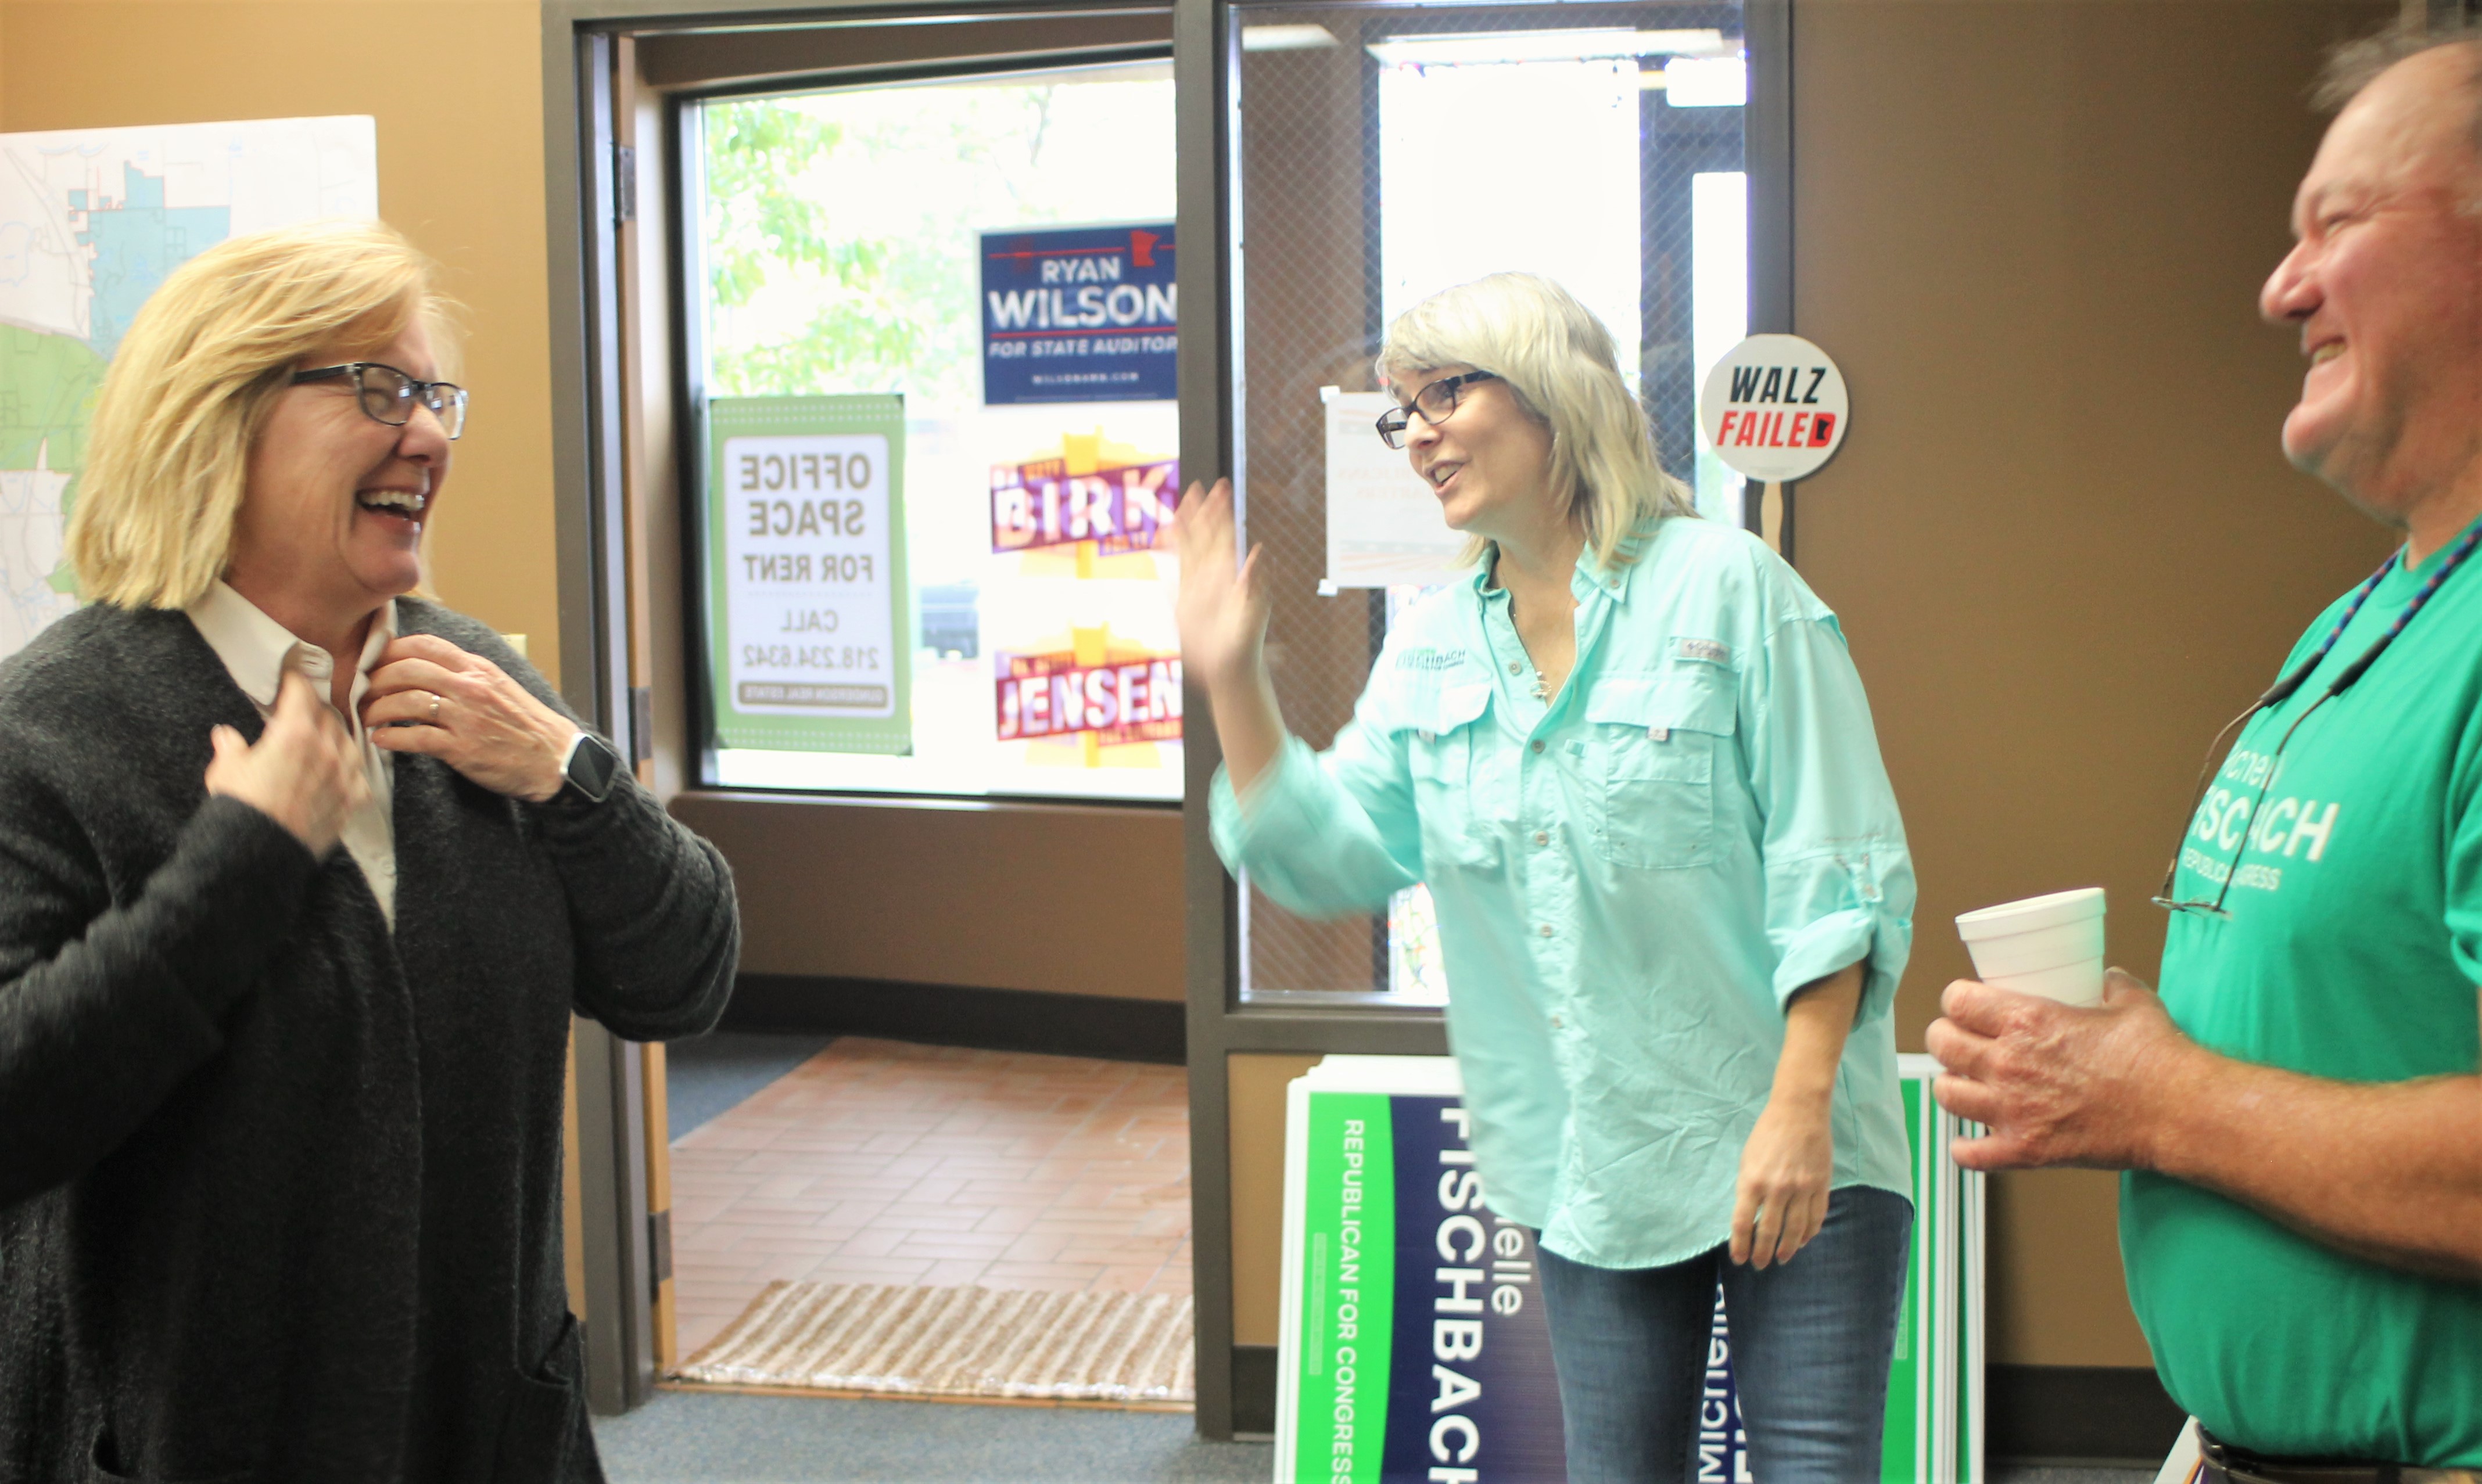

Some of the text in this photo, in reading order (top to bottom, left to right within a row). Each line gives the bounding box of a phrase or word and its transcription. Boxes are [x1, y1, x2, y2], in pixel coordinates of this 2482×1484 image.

[1041, 256, 1121, 283] RYAN
[988, 283, 1177, 329] WILSON
[989, 341, 1027, 358] FOR
[1031, 339, 1089, 356] STATE
[1730, 365, 1826, 404] WALZ
[1716, 411, 1836, 448] FAILED
[992, 463, 1175, 548] BIRK
[999, 658, 1182, 736] JENSEN
[1339, 1119, 1365, 1282] REPUBLICAN
[1337, 1288, 1360, 1340] FOR
